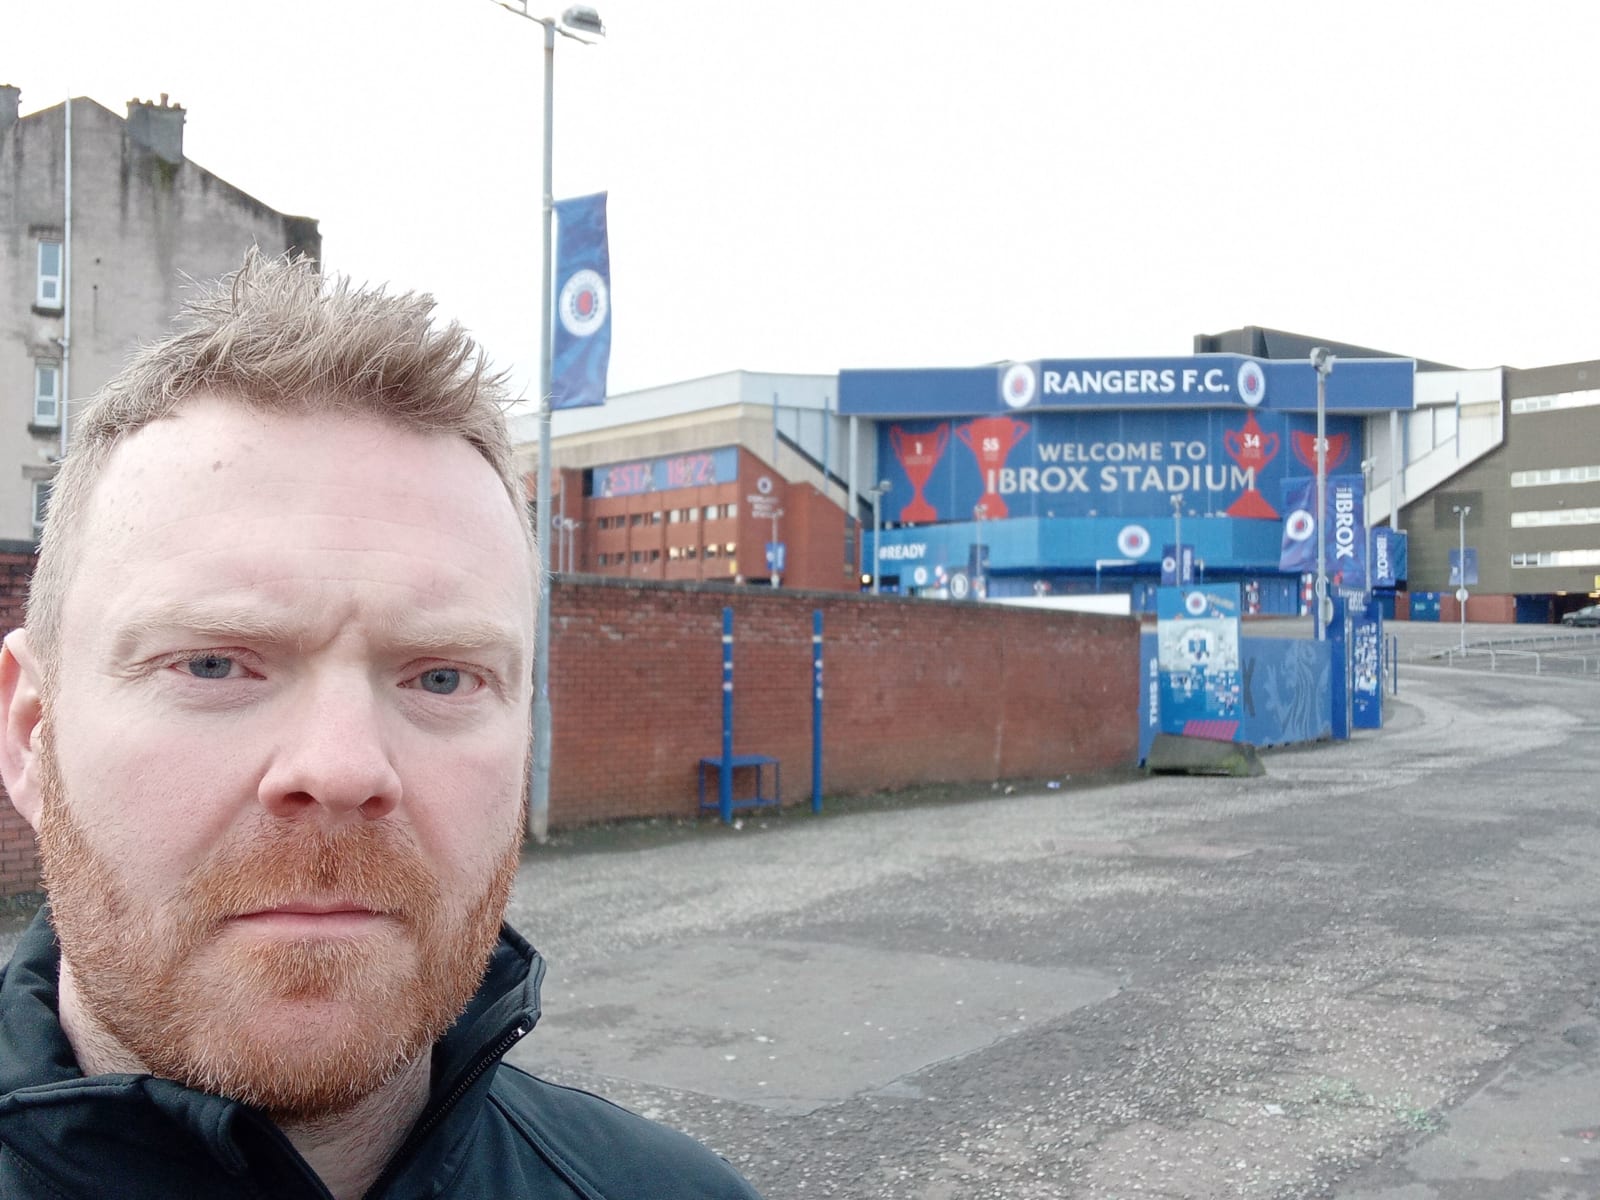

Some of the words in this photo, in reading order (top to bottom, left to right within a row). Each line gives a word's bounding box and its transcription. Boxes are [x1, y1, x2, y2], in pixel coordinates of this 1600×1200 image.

[1044, 370, 1175, 393] RANGERS
[1183, 370, 1230, 391] F.C.
[982, 438, 999, 451] 55
[1038, 442, 1164, 461] WELCOME
[1171, 441, 1206, 460] TO
[1244, 434, 1260, 448] 34
[987, 467, 1090, 493] IBROX
[1100, 465, 1255, 492] STADIUM
[1336, 492, 1354, 560] IBROX
[879, 544, 927, 561] #READY
